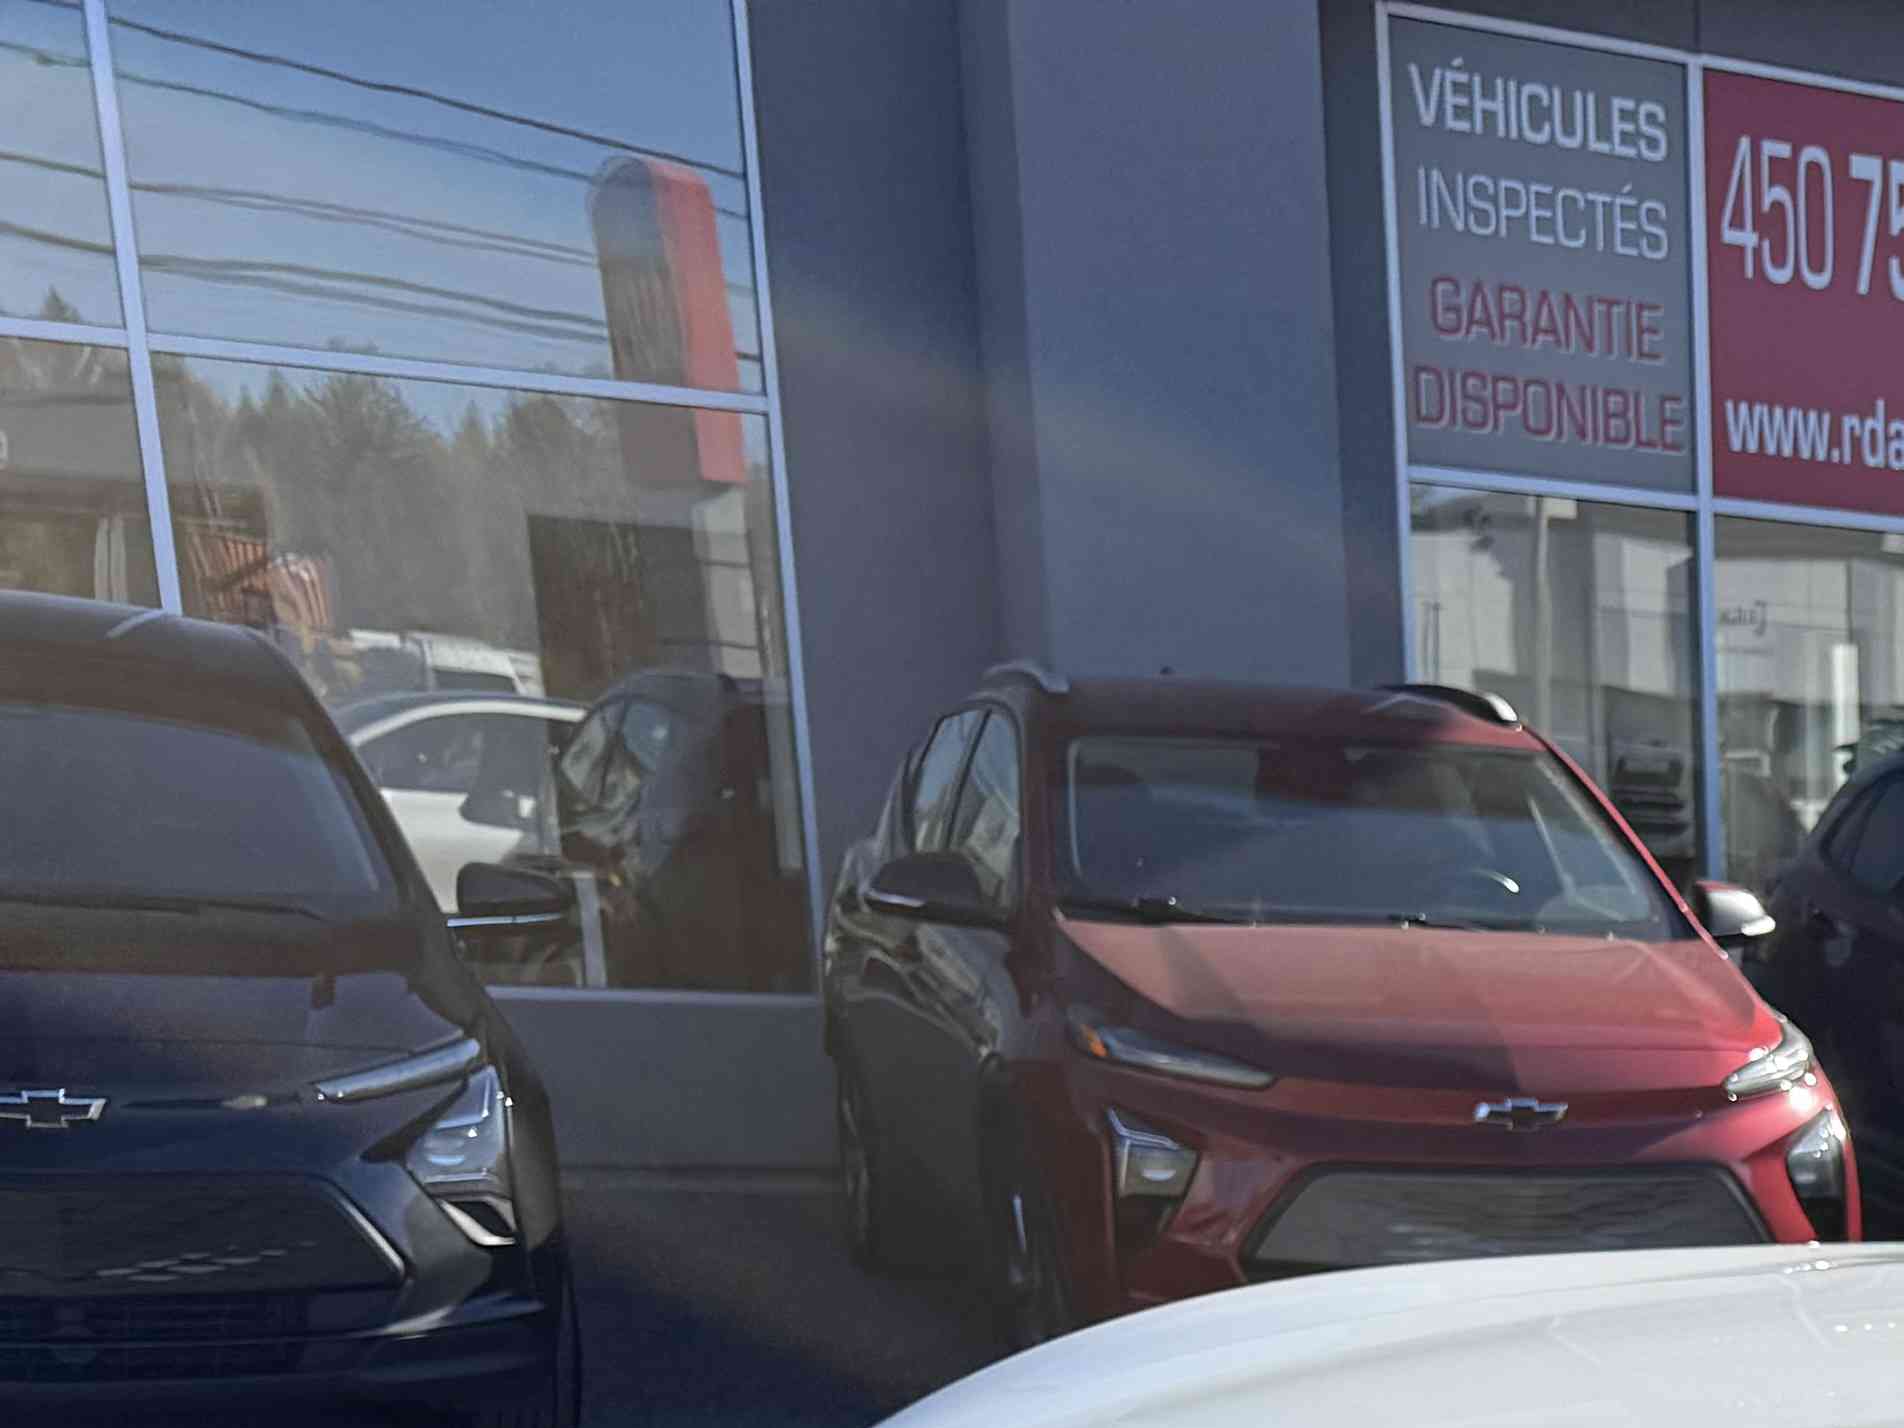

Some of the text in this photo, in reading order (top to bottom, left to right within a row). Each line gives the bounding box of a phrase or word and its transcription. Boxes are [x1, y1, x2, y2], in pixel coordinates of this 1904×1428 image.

[1407, 56, 1668, 162] VÉHICULES
[1417, 164, 1669, 260] INSPECTÉS
[1720, 135, 1834, 290] 450
[1431, 276, 1665, 365] GARANTIE
[1413, 364, 1686, 456] DISPONIBLE
